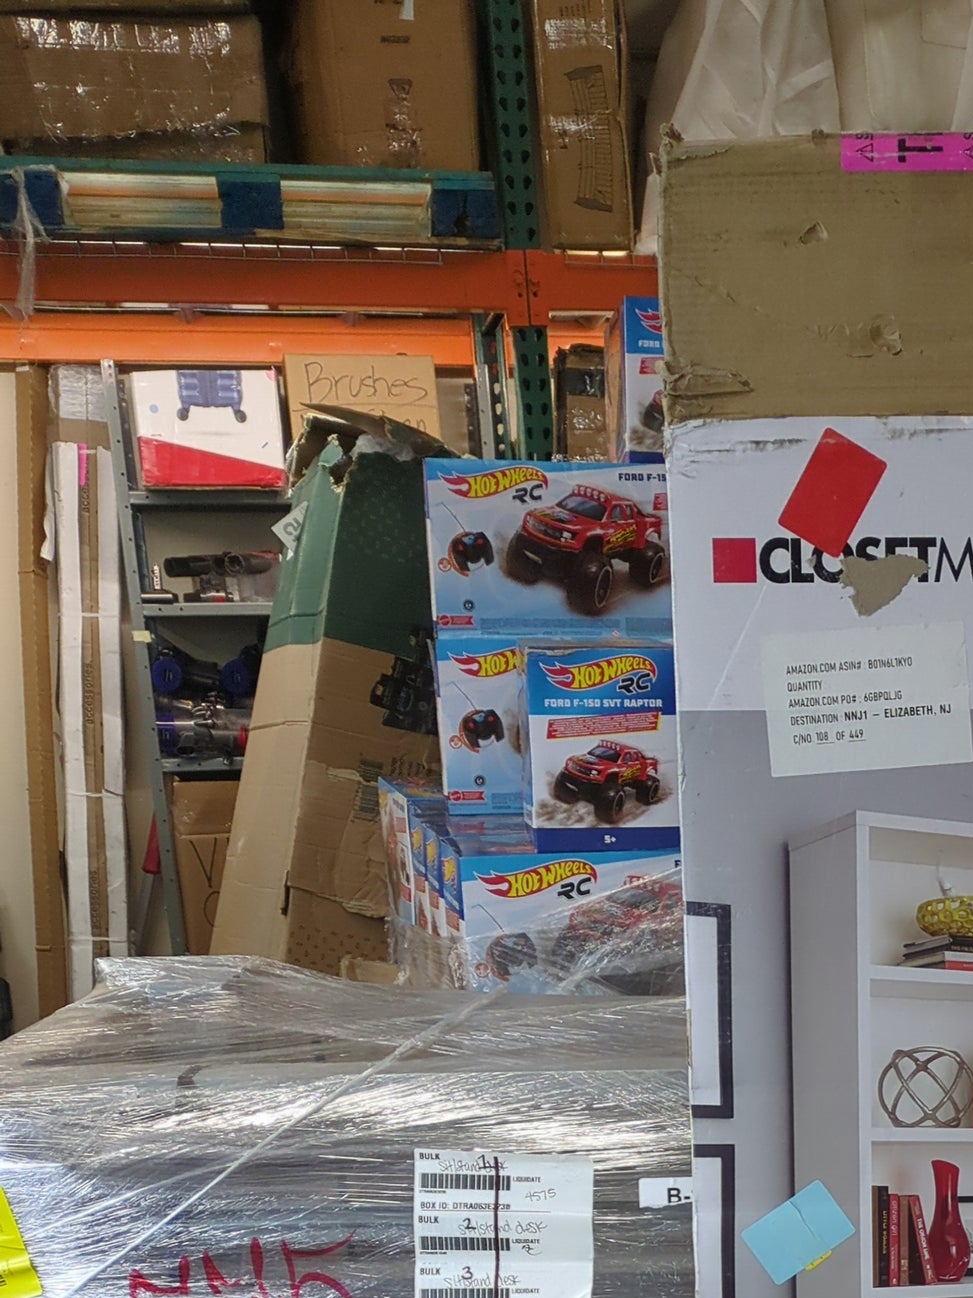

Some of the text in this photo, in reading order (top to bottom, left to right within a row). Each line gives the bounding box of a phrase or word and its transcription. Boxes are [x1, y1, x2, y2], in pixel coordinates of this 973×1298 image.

[303, 361, 429, 404] Brushes
[618, 471, 667, 482] FORD F-15
[512, 485, 543, 503] RC
[786, 661, 837, 676] AMAZON.COM
[617, 673, 651, 694] RC
[787, 680, 823, 693] QUANTITY
[544, 698, 663, 708] FORD F-150 SVT RAPTOR
[788, 695, 839, 709] AMAZON.COM
[790, 713, 839, 726] DESTINATION
[939, 703, 952, 715] NJ
[835, 731, 846, 741] OF
[604, 835, 617, 843] 5+
[557, 877, 592, 900] RC
[419, 1152, 440, 1160] BULK
[513, 1175, 542, 1183] LIQUIDATE
[418, 1215, 440, 1224] BULK
[463, 1217, 477, 1231] 2
[419, 1267, 441, 1276] BULK
[460, 1265, 474, 1281] 3
